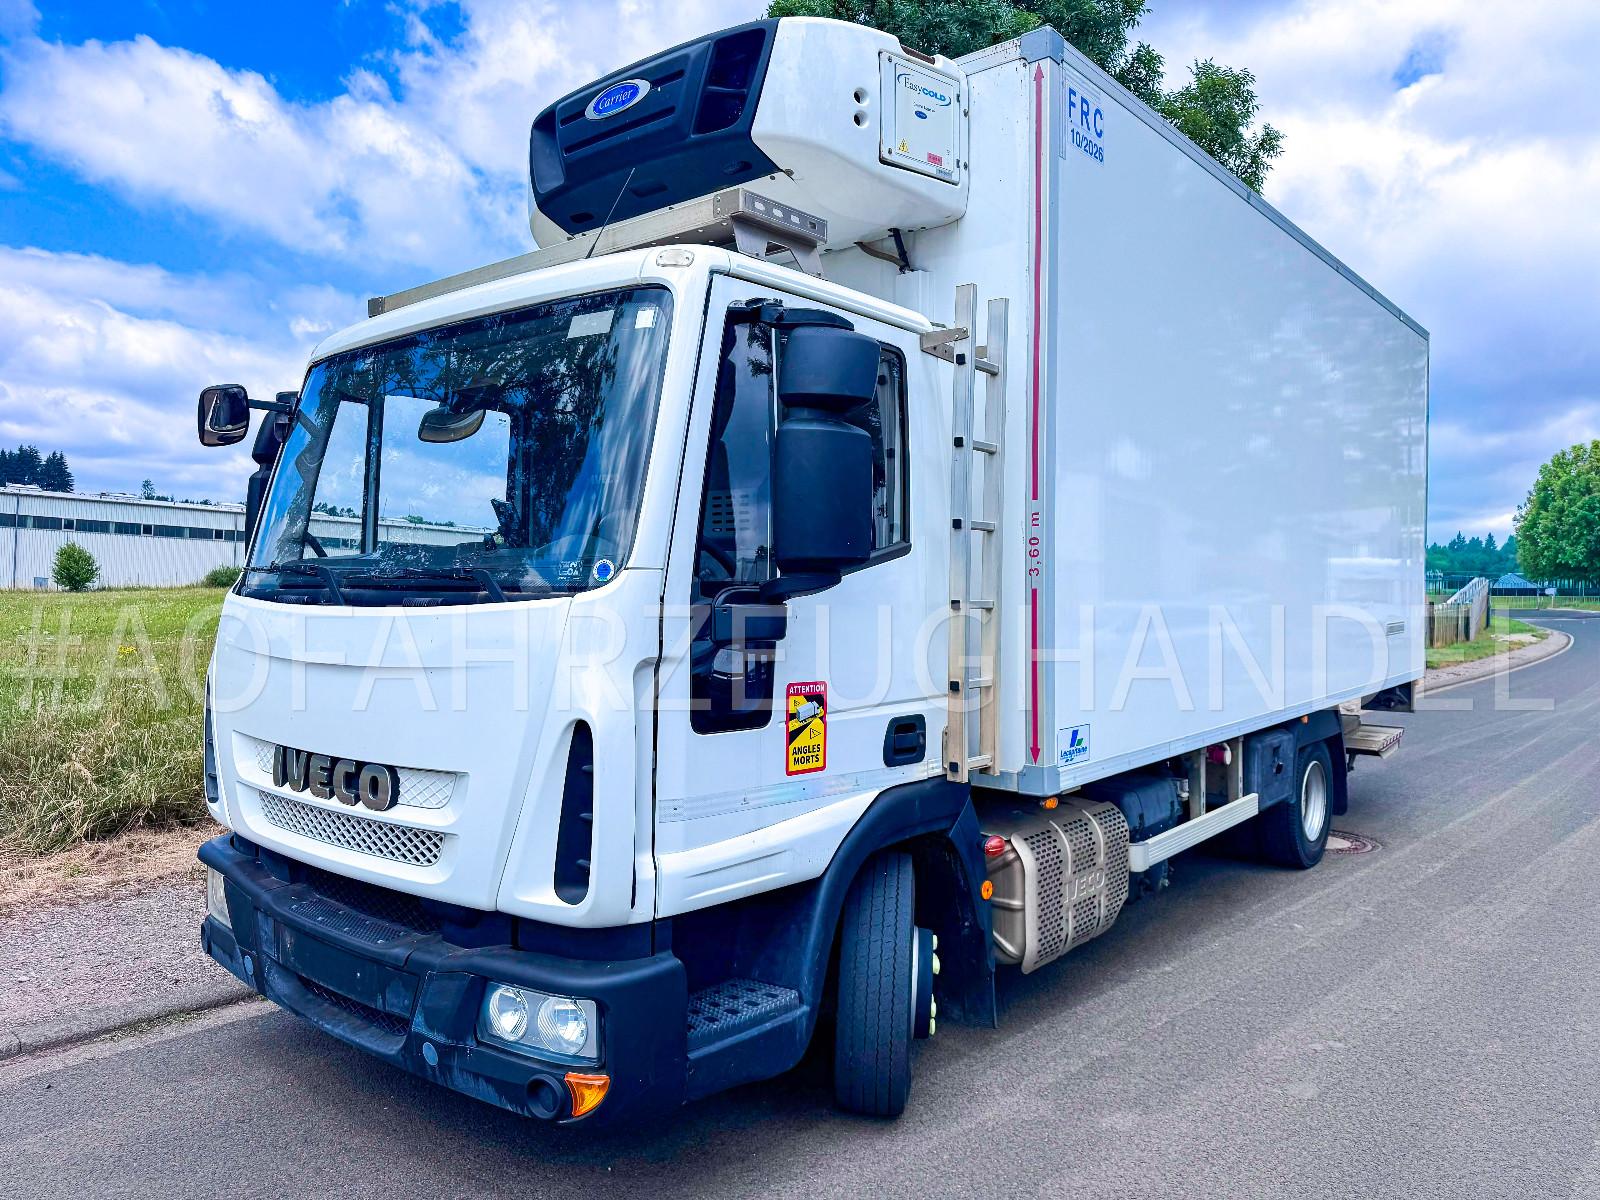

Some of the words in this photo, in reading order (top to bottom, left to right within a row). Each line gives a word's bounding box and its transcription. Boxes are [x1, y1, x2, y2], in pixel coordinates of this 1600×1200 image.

[598, 89, 633, 110] Carrier
[904, 76, 947, 102] EasyCOLD
[1070, 127, 1104, 163] 10/2026
[1031, 511, 1040, 527] m
[1028, 536, 1042, 577] 3,60
[789, 684, 825, 694] ATTENTION
[792, 743, 821, 756] ANGLES
[793, 754, 820, 766] MORTS
[272, 745, 395, 812] IVECO
[1063, 866, 1106, 904] IVECO
